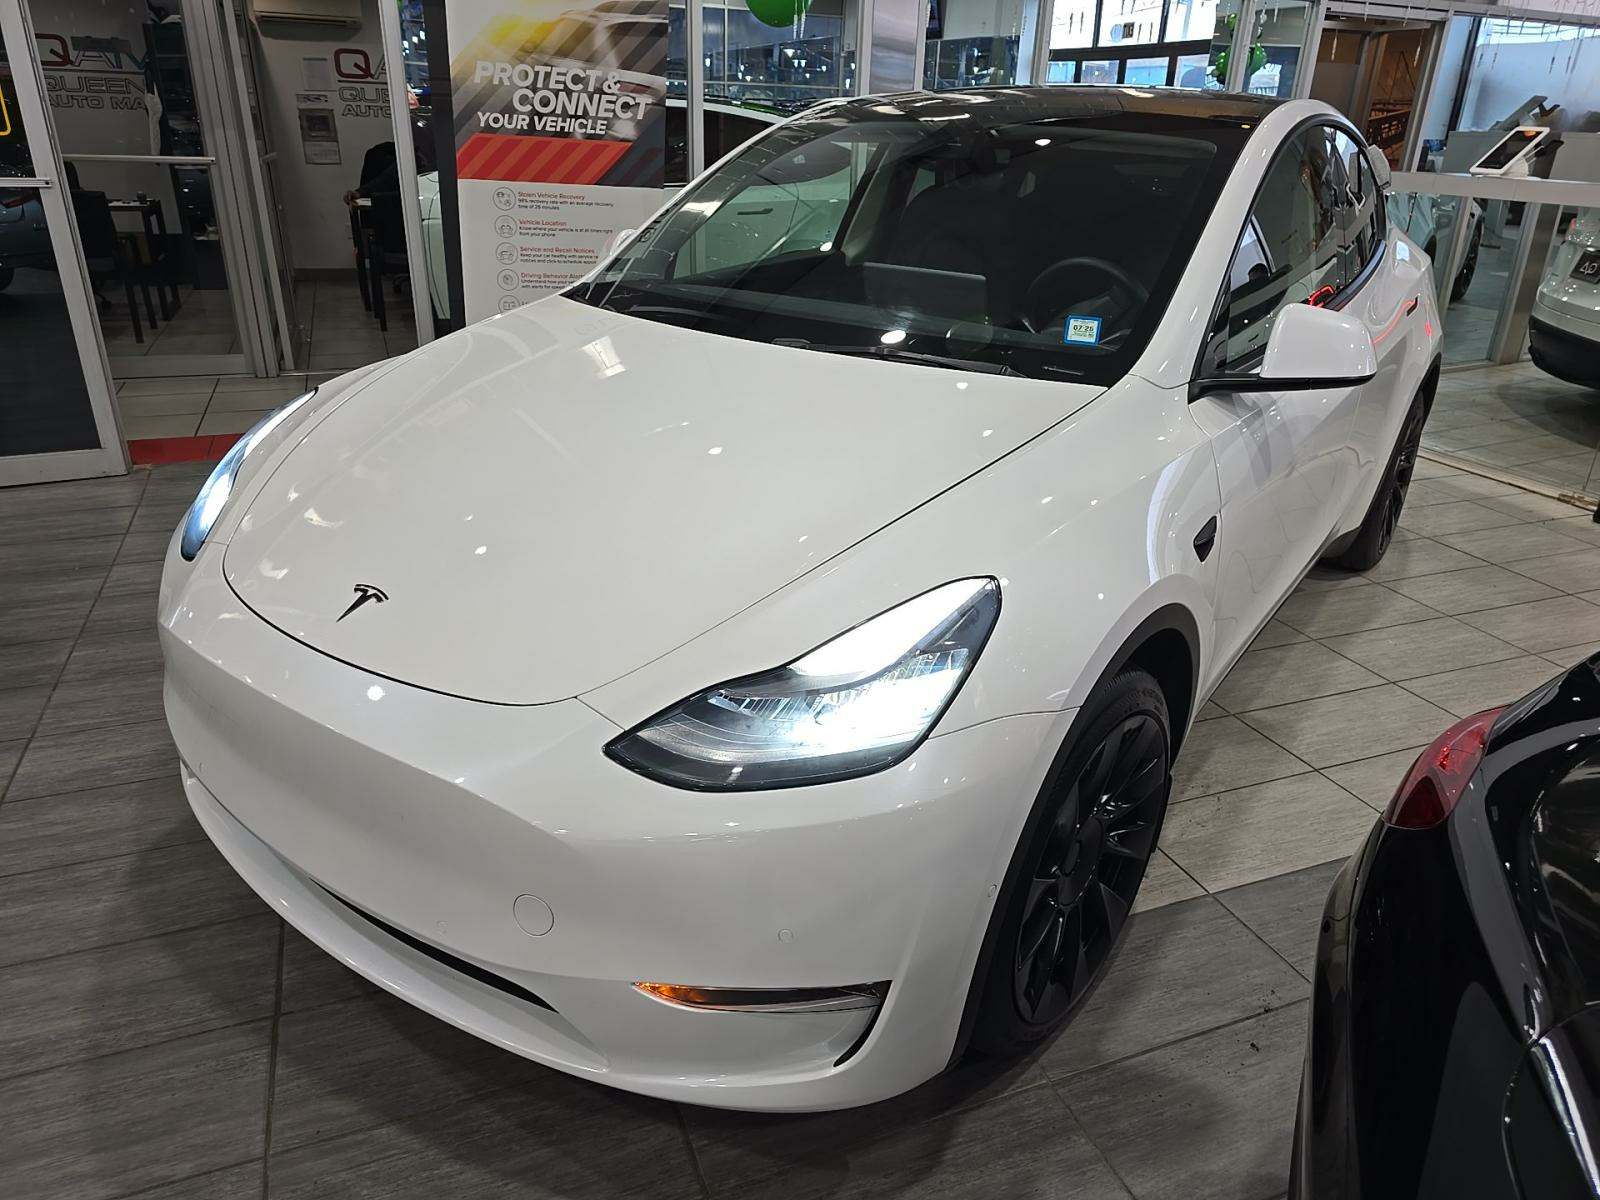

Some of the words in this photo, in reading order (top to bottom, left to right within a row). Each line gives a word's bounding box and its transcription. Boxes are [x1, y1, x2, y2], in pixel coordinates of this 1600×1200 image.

[473, 60, 603, 92] PROTECT
[602, 70, 621, 94] &
[512, 88, 654, 120] CONNECT
[477, 111, 530, 130] YOUR
[533, 115, 608, 135] VEHICLE
[559, 193, 585, 201] Recovery
[519, 218, 541, 226] Vehicle
[521, 272, 542, 280] Driving
